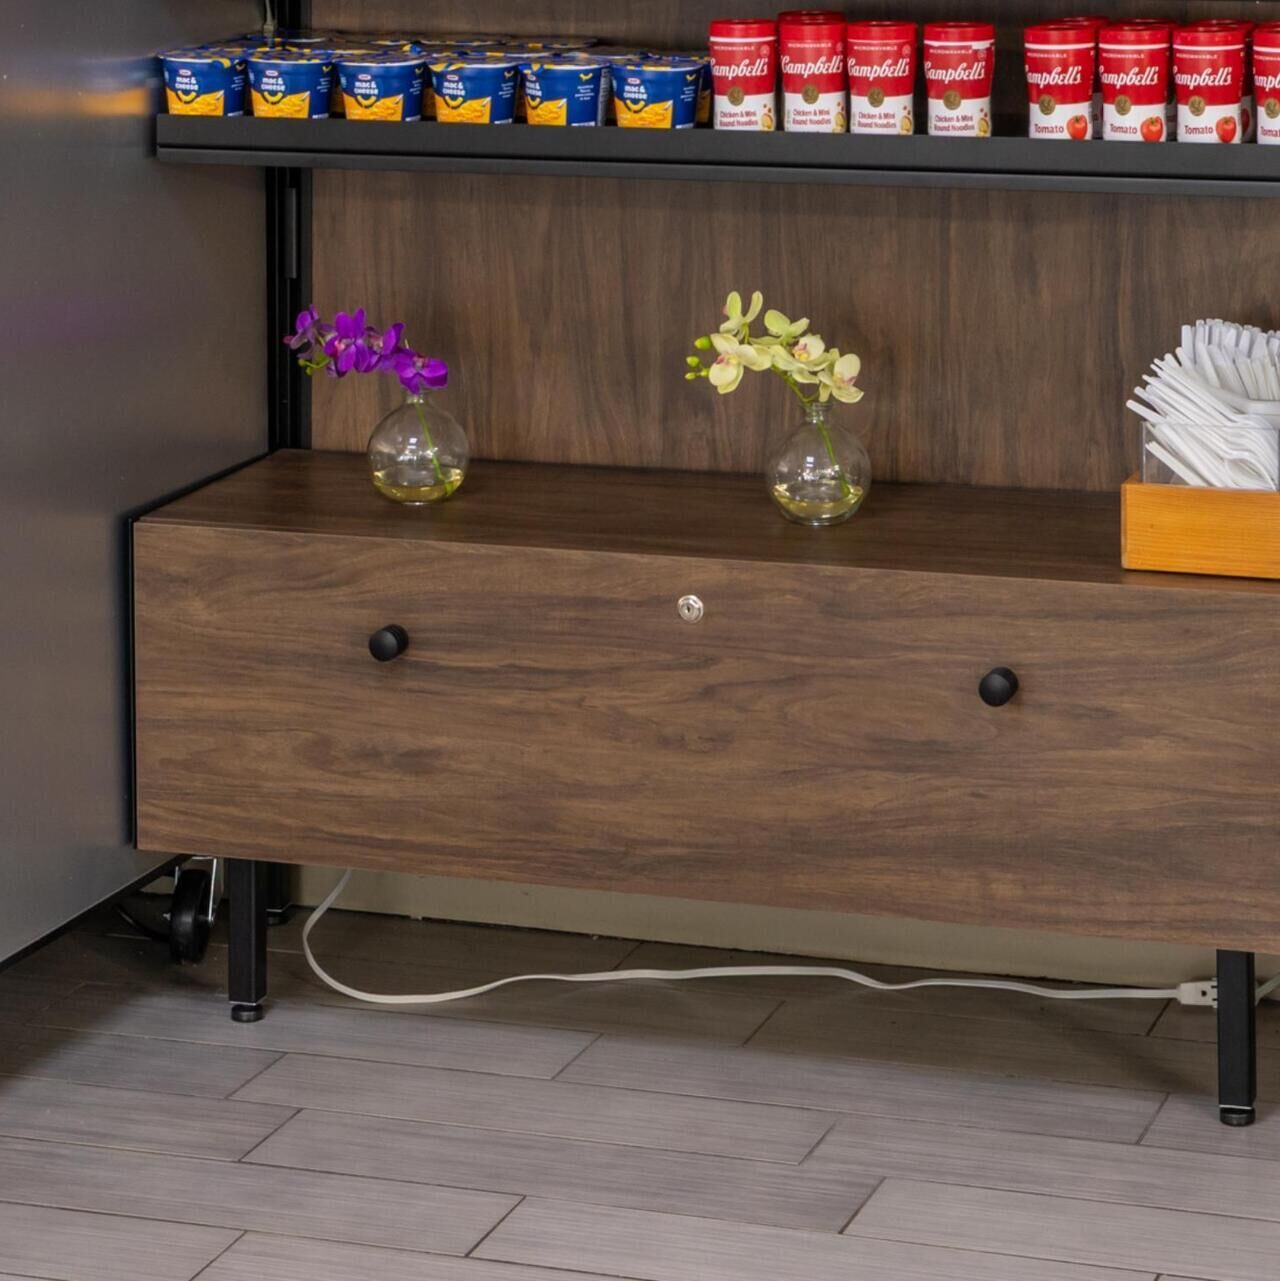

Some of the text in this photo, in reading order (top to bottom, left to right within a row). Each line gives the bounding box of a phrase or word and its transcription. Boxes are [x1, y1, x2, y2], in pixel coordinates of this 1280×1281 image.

[781, 55, 844, 78] Campbell's
[847, 57, 910, 81] Campbell's
[1034, 123, 1064, 134] Tomato
[1110, 124, 1138, 135] Tomato
[1184, 124, 1214, 135] Tomato
